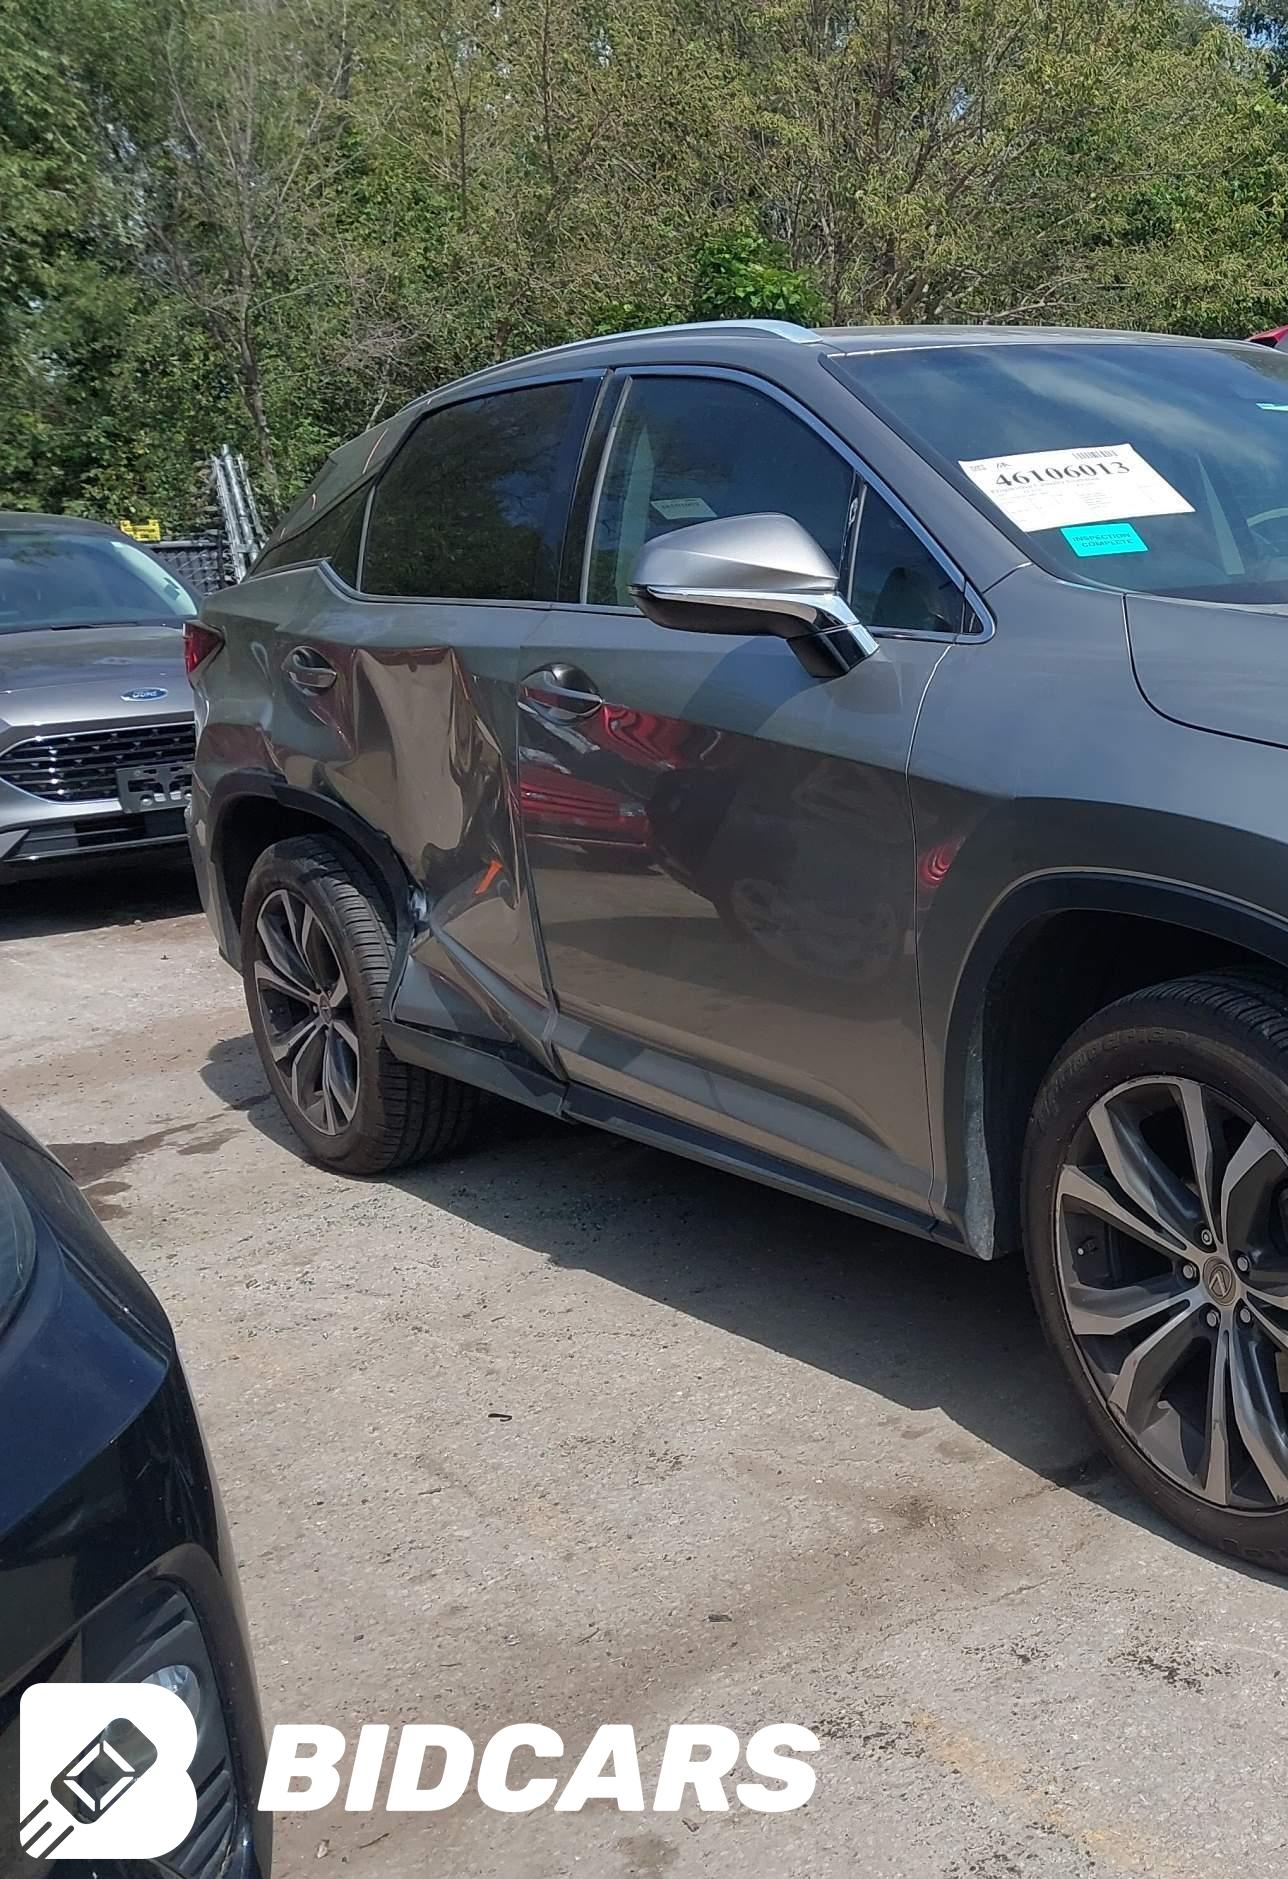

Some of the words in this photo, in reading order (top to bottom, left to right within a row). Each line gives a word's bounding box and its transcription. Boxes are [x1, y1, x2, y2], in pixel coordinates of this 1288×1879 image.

[995, 461, 1130, 486] 46106013
[1072, 533, 1131, 542] INSPECTION
[1081, 539, 1134, 548] COMPLETE
